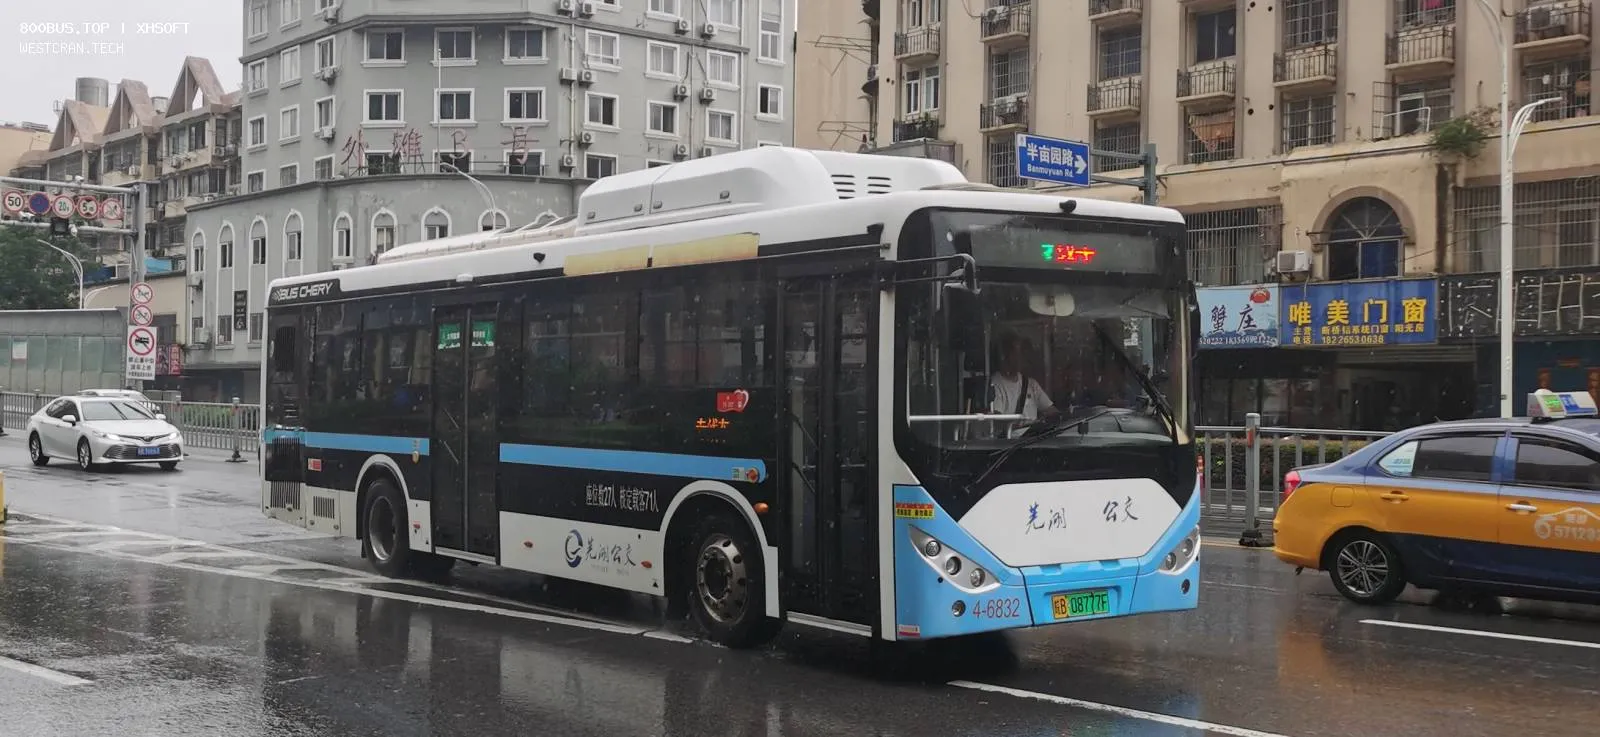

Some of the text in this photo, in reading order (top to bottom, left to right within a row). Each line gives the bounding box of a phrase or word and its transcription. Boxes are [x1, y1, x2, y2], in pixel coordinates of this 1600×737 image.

[1027, 142, 1074, 167] 半亩园路
[7, 196, 21, 206] 50
[300, 282, 333, 298] CHERY
[1211, 304, 1258, 334] 蟹庄
[1289, 297, 1428, 326] 唯美门窗
[1025, 496, 1139, 535] 芜湖 公交
[972, 598, 1020, 619] 4-6832
[1070, 593, 1107, 614] 08777F
